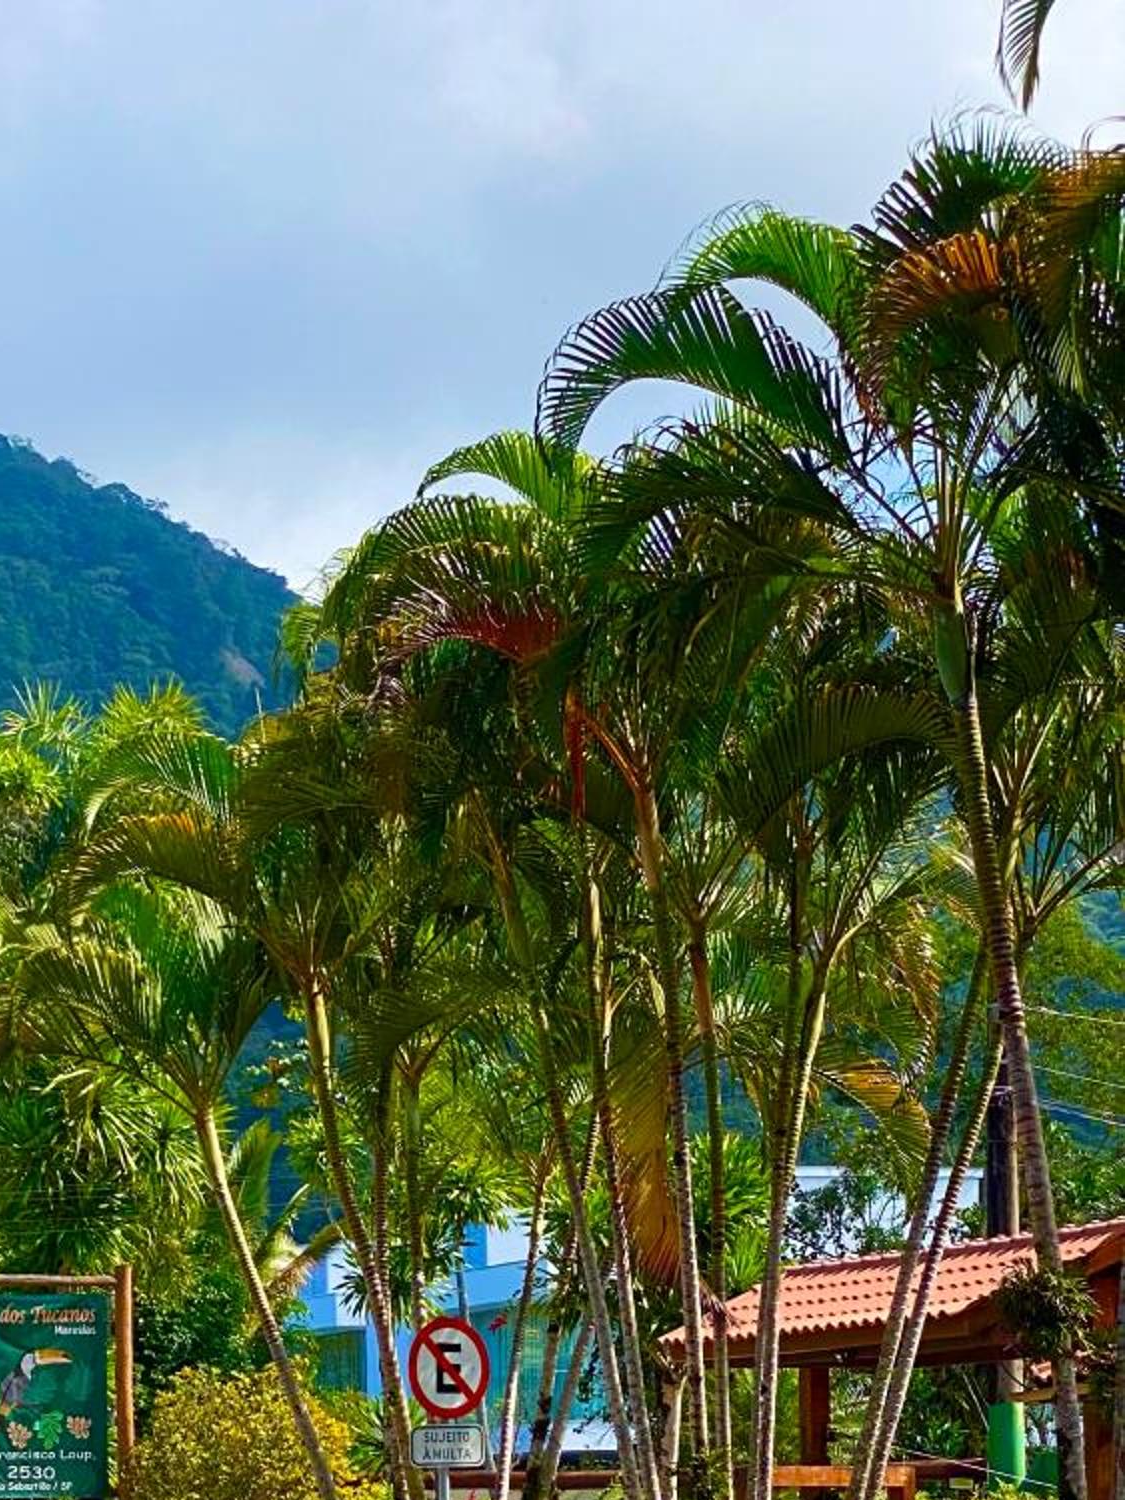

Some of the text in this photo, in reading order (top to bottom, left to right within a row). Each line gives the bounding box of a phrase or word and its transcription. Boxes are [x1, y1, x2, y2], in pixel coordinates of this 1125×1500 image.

[0, 1302, 26, 1324] dos
[30, 1304, 96, 1324] Tucanos
[424, 1431, 470, 1443] SUJEITO
[433, 1447, 472, 1460] MULTA
[7, 1465, 56, 1480] 2530
